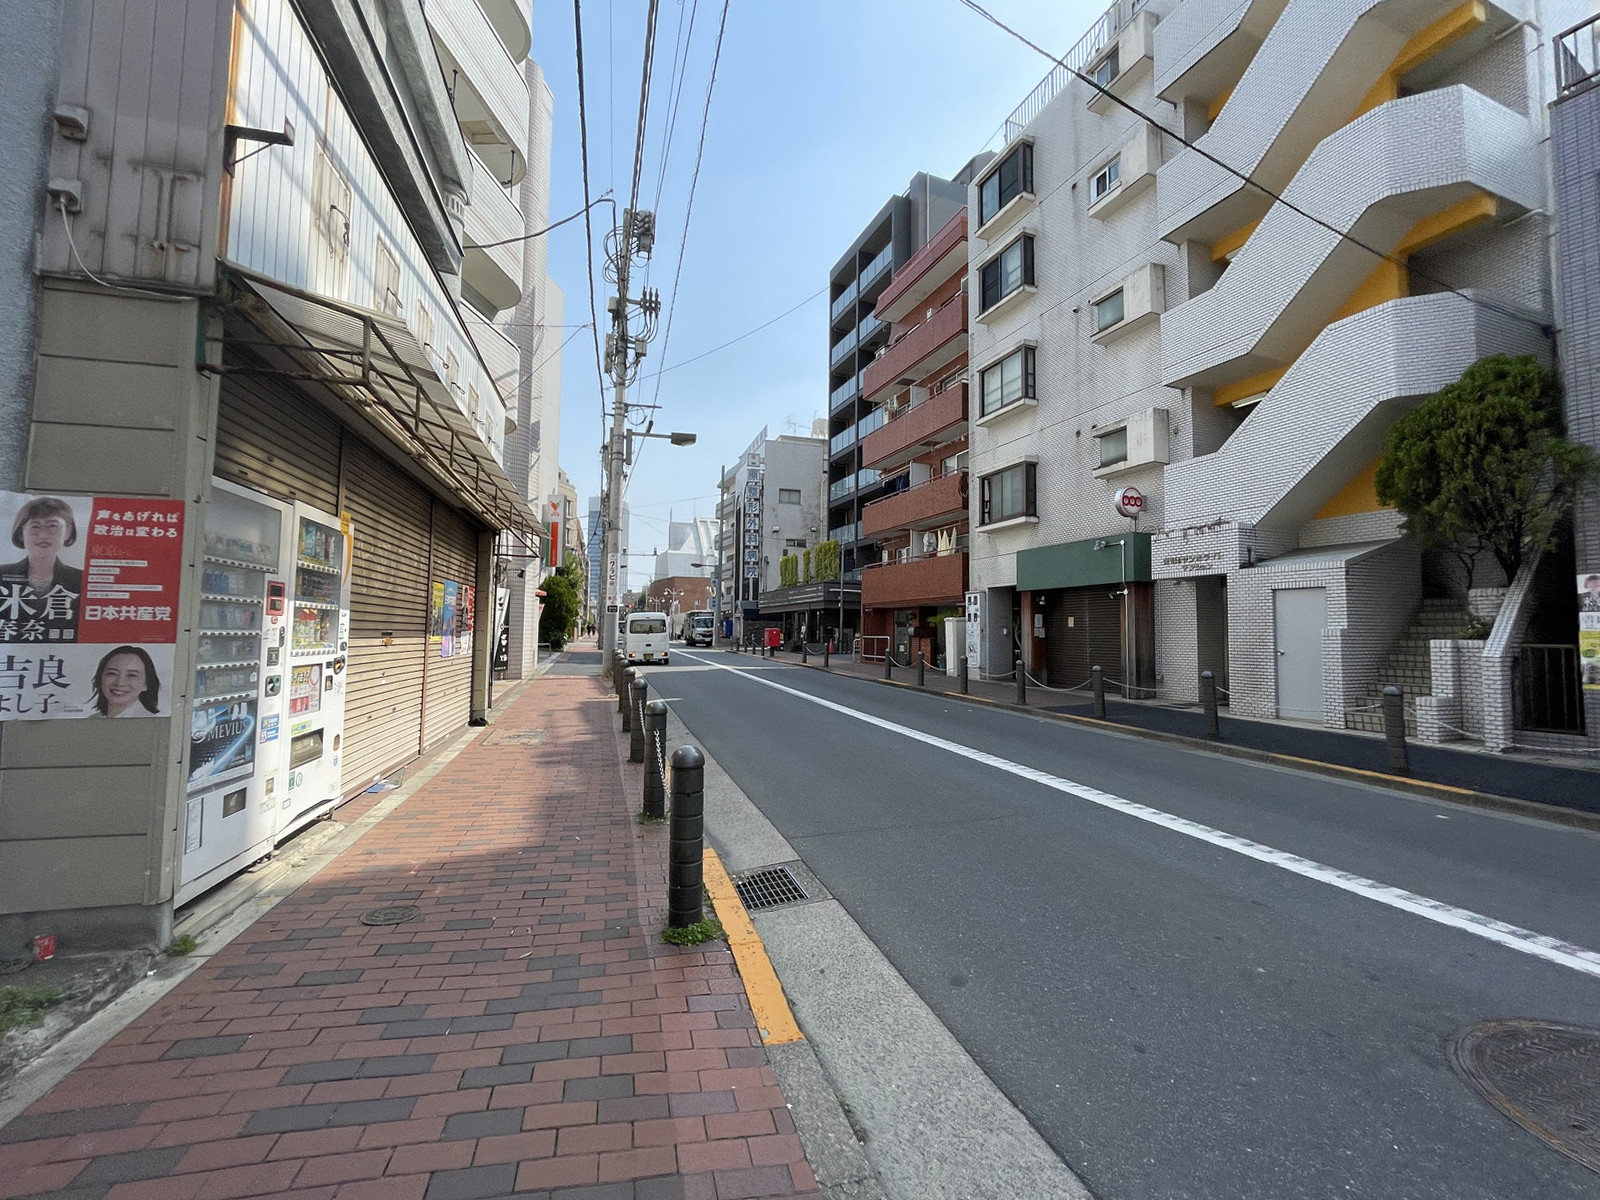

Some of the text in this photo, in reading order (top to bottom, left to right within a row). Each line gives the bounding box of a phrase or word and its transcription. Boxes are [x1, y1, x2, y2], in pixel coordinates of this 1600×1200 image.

[96, 510, 179, 523] 声をあげれば
[93, 525, 178, 538] 政治は変わる
[0, 583, 80, 620] 米倉
[84, 605, 172, 621] 日本共産党
[0, 654, 71, 689] 吉良
